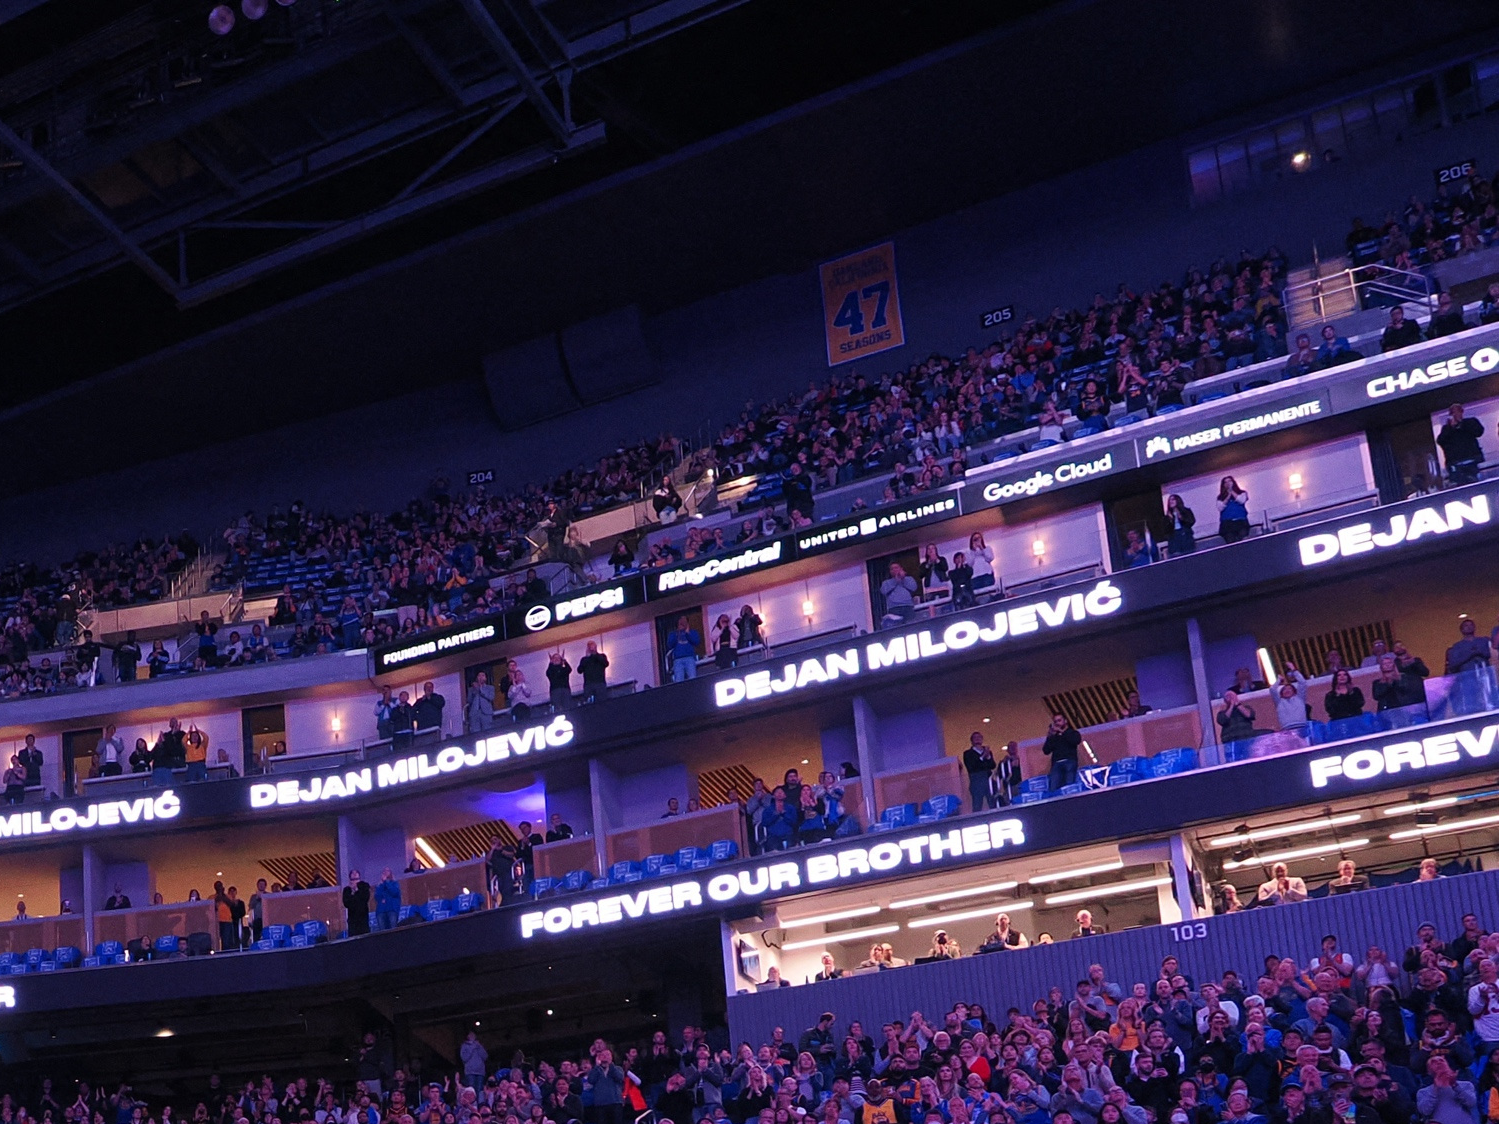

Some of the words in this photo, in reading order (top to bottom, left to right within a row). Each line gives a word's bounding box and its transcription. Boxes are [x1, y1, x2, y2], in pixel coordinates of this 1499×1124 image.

[833, 280, 890, 335] 47
[984, 308, 1012, 326] 205
[839, 330, 891, 354] SEASONS
[1366, 354, 1469, 398] CHASE
[1173, 427, 1222, 452] KAISER
[1223, 399, 1322, 437] PERMANENTE
[469, 471, 493, 484] 204
[983, 470, 1054, 502] Google
[1055, 452, 1113, 483] Cloud
[799, 525, 859, 549] UNITED
[878, 499, 955, 528] AIRLINES
[1297, 494, 1491, 566] DEJAN
[658, 541, 782, 591] RingCentral
[555, 586, 624, 621] PEPSI
[383, 641, 437, 665] FOUNDING
[438, 625, 495, 650] PARTNERS
[715, 649, 860, 707] DEJAN
[867, 577, 1123, 671] MILOJEVIĆ
[249, 770, 373, 808] DEJAN
[376, 714, 574, 788] MILOJEVIĆ
[1309, 724, 1499, 788] FOREV
[520, 881, 703, 939] FOREVER
[707, 861, 802, 902] OUR
[806, 818, 1026, 885] BROTHER
[1171, 923, 1207, 942] 103
